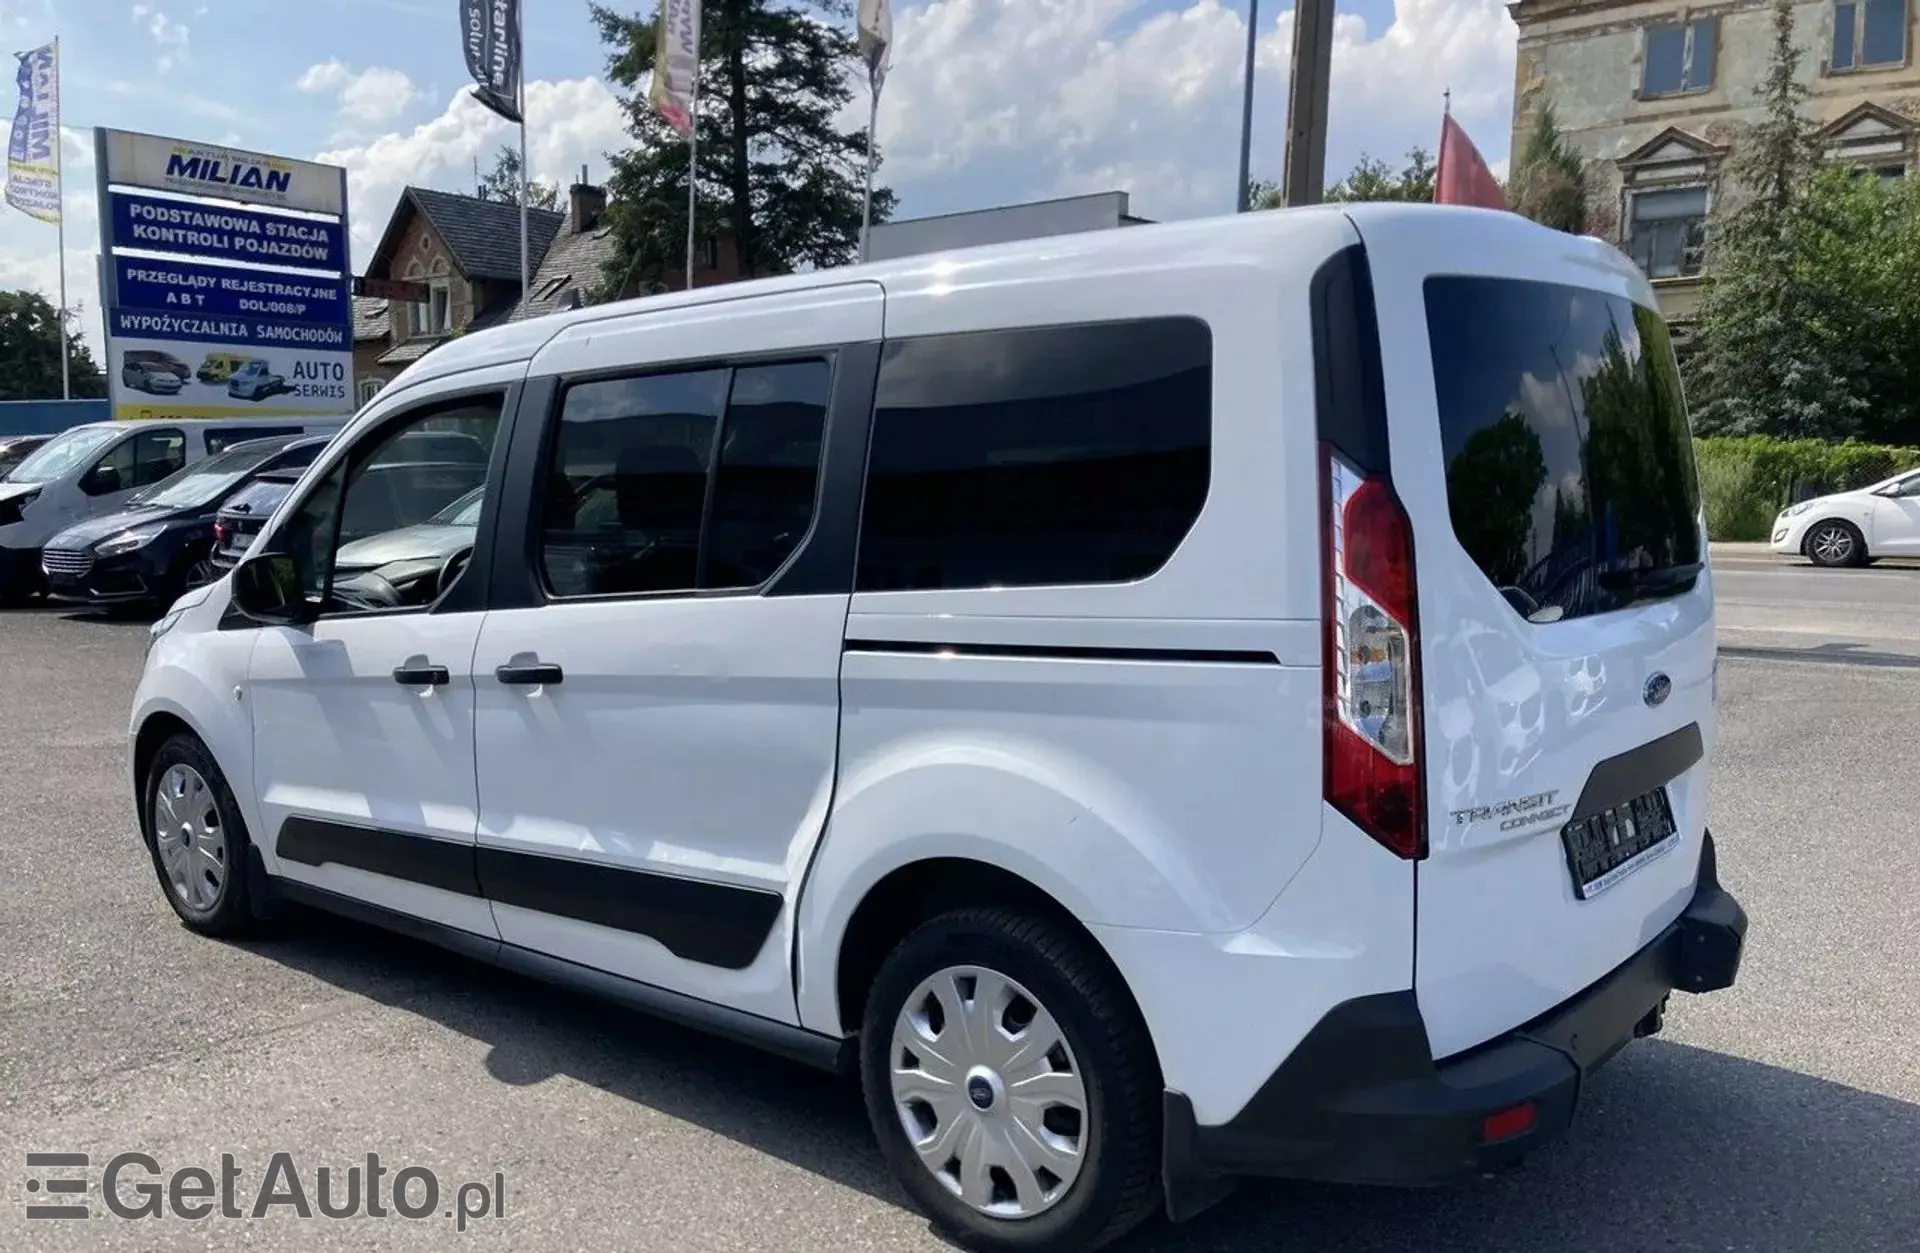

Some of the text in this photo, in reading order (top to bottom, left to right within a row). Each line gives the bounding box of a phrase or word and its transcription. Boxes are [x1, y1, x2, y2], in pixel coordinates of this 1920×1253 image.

[166, 154, 291, 192] MILIAN
[129, 203, 329, 242] PODSTAWOWA STACJA
[133, 223, 329, 261] KONTROLI POJAZDÓW
[127, 268, 337, 300] PRZEGLĄDY REJESTRACYJNE
[120, 314, 343, 344] WYPOŻYCZALNIA SAMOCHODÓW
[293, 360, 345, 381] AUTO
[293, 384, 346, 399] SERWIS
[1449, 789, 1560, 826] TRANSIT
[1500, 803, 1573, 832] CONNECT
